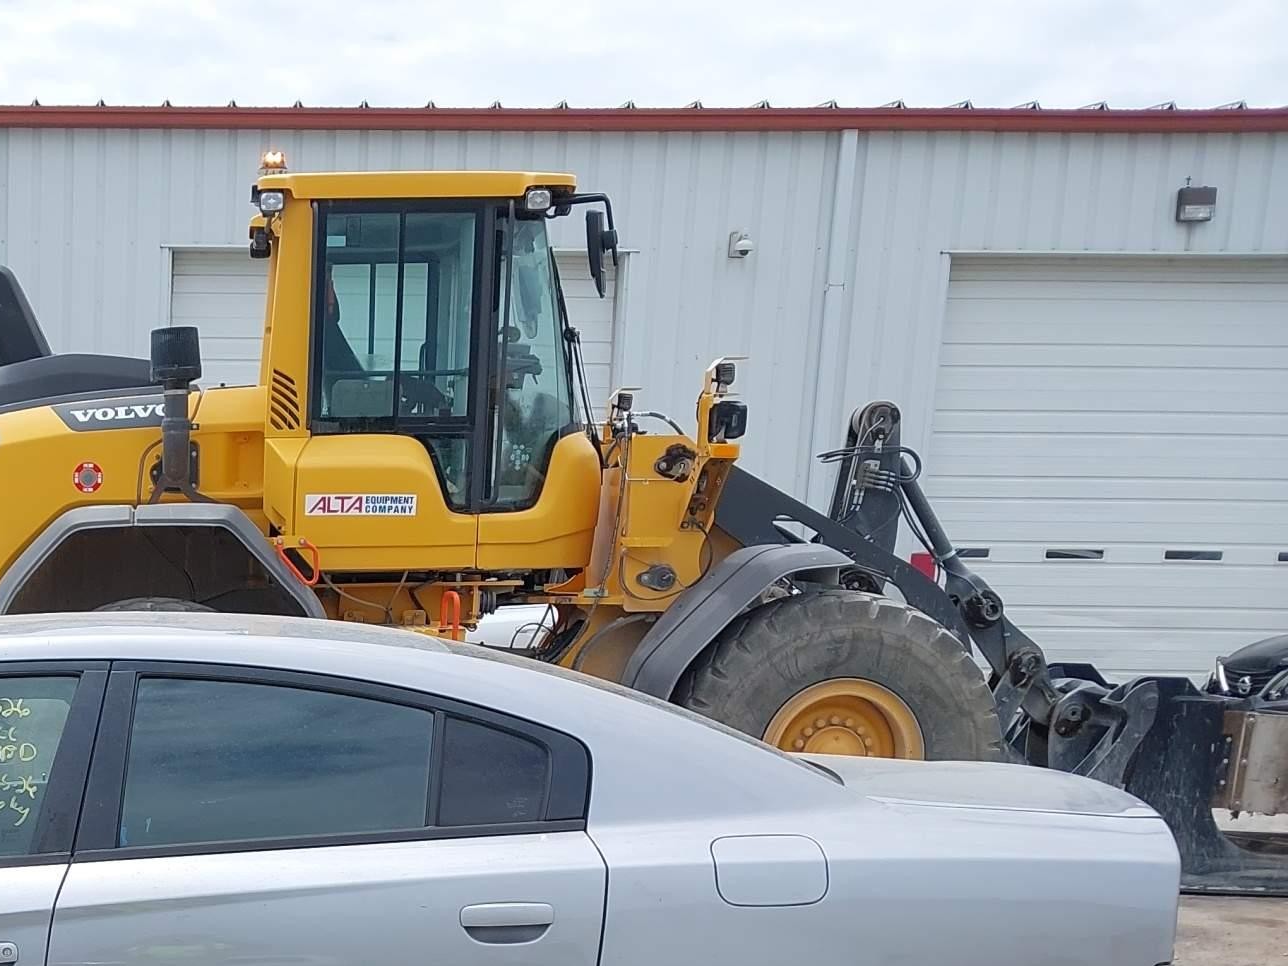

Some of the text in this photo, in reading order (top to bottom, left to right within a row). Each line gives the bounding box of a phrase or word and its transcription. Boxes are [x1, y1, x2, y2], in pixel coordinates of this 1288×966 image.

[365, 496, 414, 504] EQUIPMENT
[307, 496, 363, 513] ALTA
[365, 505, 414, 513] COMPANY
